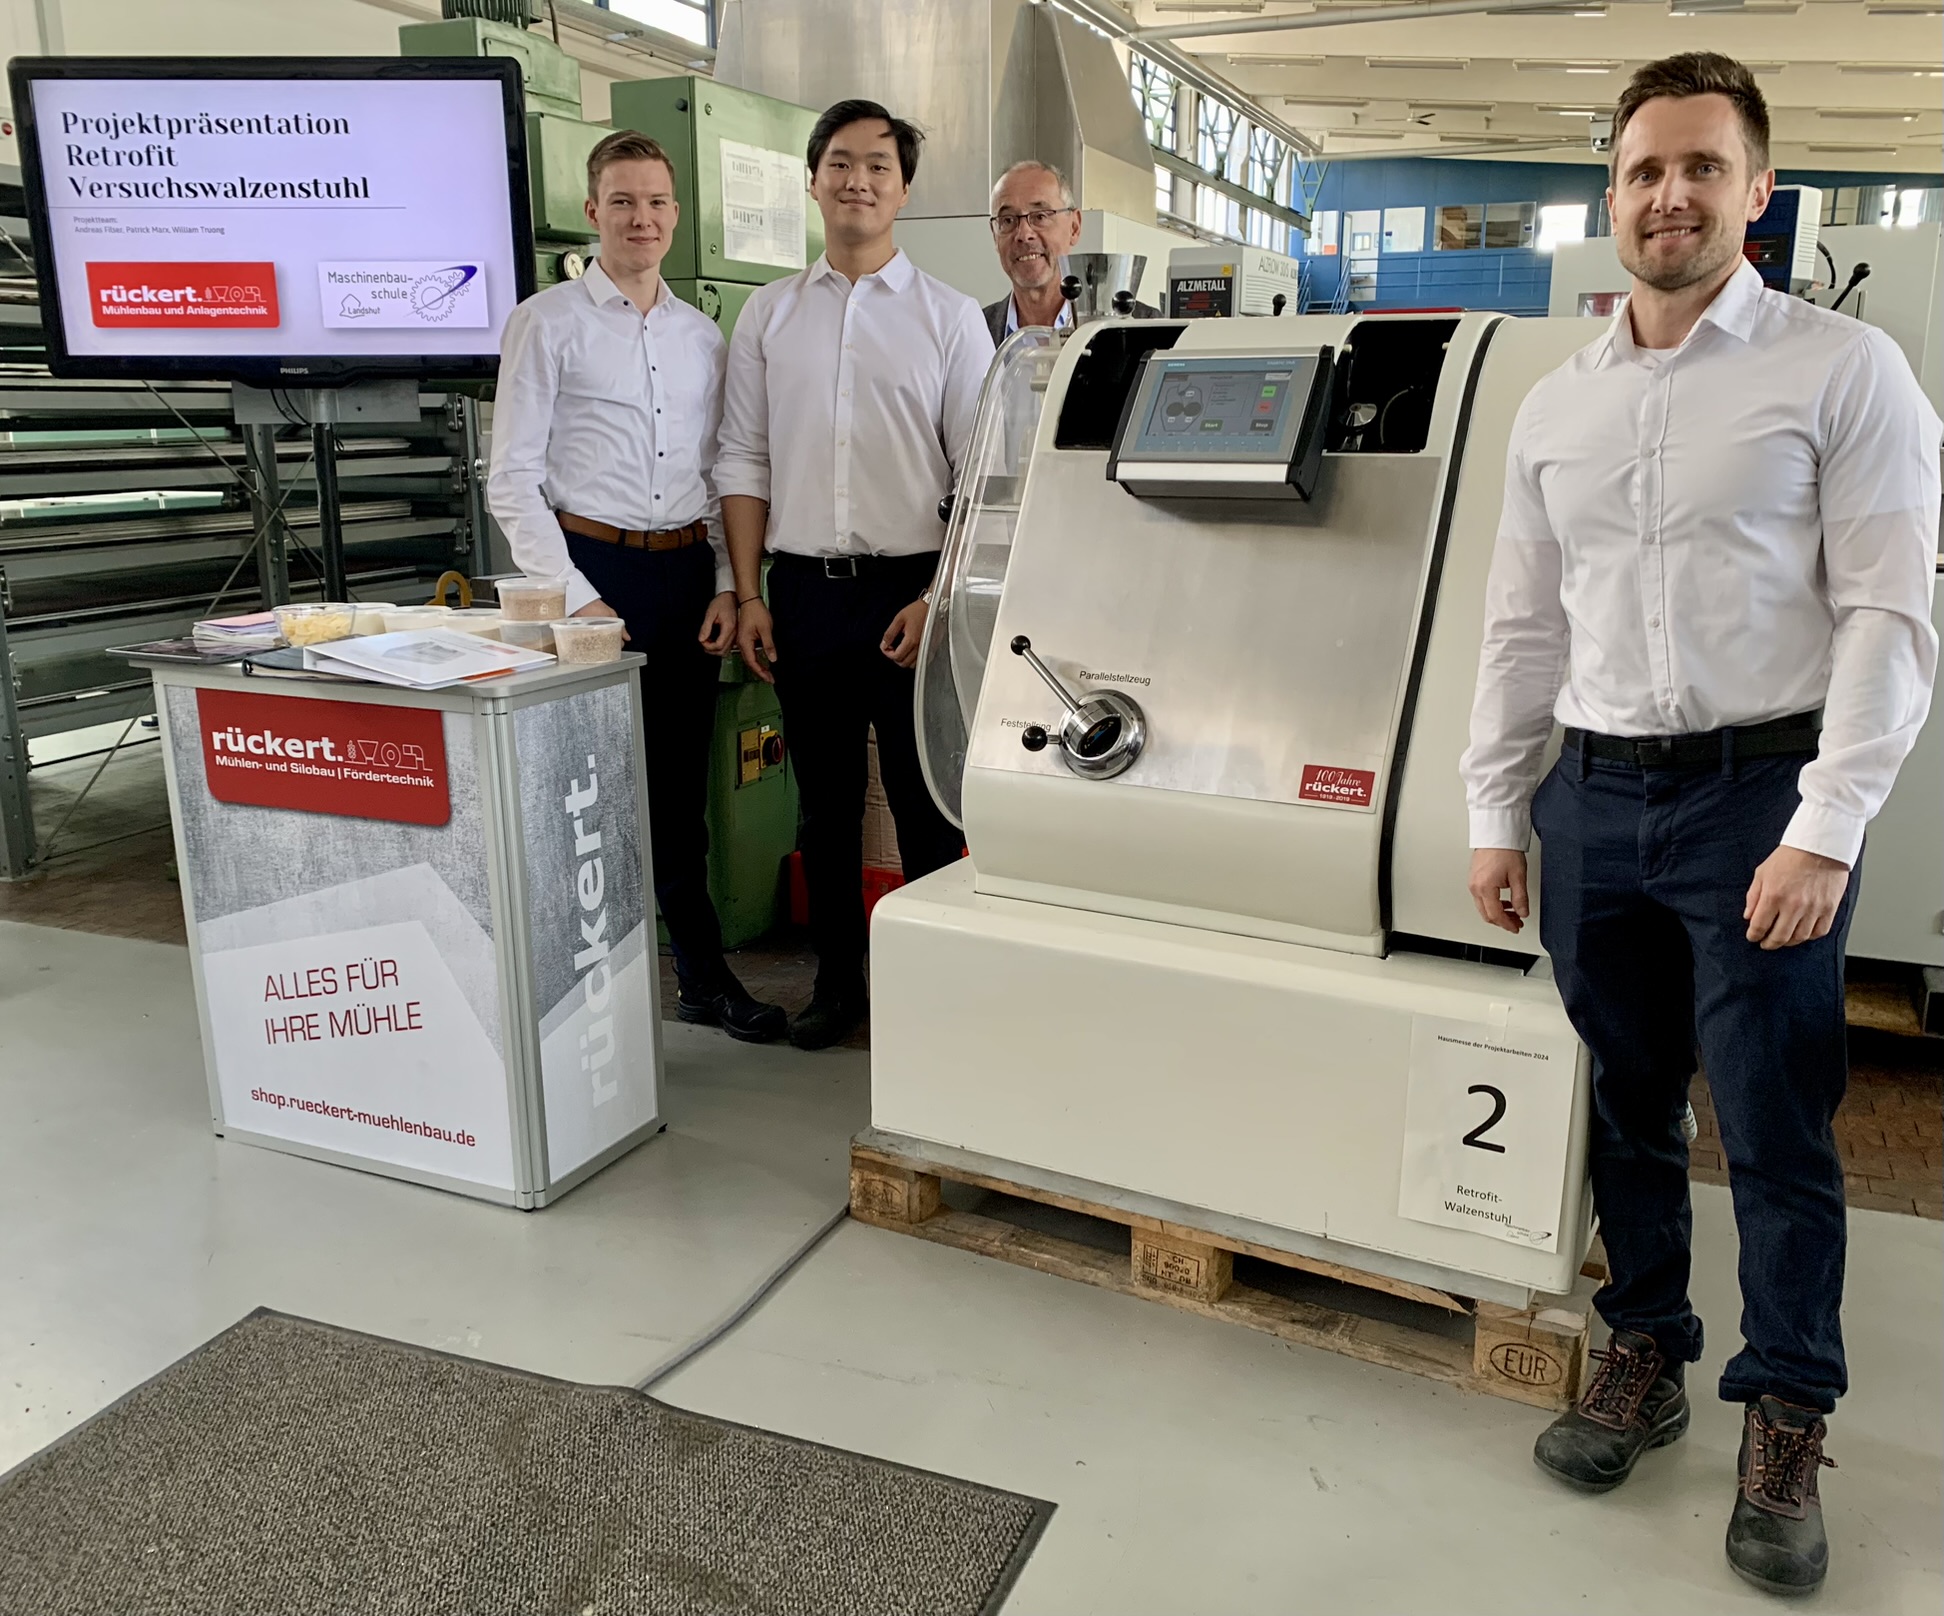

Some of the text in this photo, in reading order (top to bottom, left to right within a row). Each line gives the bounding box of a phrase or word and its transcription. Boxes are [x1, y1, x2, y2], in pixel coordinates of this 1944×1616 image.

[61, 111, 351, 140] Projektpräsentation
[66, 144, 179, 167] Retrofit
[68, 176, 371, 199] Versuchswalzenstuhl
[200, 226, 225, 235] Truong
[327, 271, 414, 283] Maschinenbau-
[1177, 279, 1226, 292] ALZMETALL
[100, 285, 203, 303] rückert.
[371, 288, 408, 299] schule
[102, 305, 268, 317] Mühlenbau und Anlagentechnik
[348, 306, 380, 315] Landshut
[1079, 670, 1151, 686] Parallelstellzeug
[211, 727, 344, 762] rückert.
[215, 755, 263, 769] Mühlen-
[265, 761, 287, 773] und
[290, 763, 335, 777] Silobau
[343, 768, 434, 788] Fördertechnik
[1316, 769, 1361, 786] 100 Jahre
[1305, 781, 1367, 797] rückert.
[564, 753, 618, 1110] rückert.
[264, 957, 399, 1002] ALLES FÜR
[265, 1002, 423, 1045] IHRE MÜHLE
[1437, 1035, 1549, 1061] Hausmesse der Projektarbeiten 2024
[251, 1087, 476, 1147] shop.rueckert-muehlenbau.de
[1462, 1084, 1507, 1154] 2
[1456, 1185, 1503, 1204] Retrofit-
[1444, 1200, 1512, 1225] Walzenstuhl
[1503, 1347, 1548, 1382] EUR
